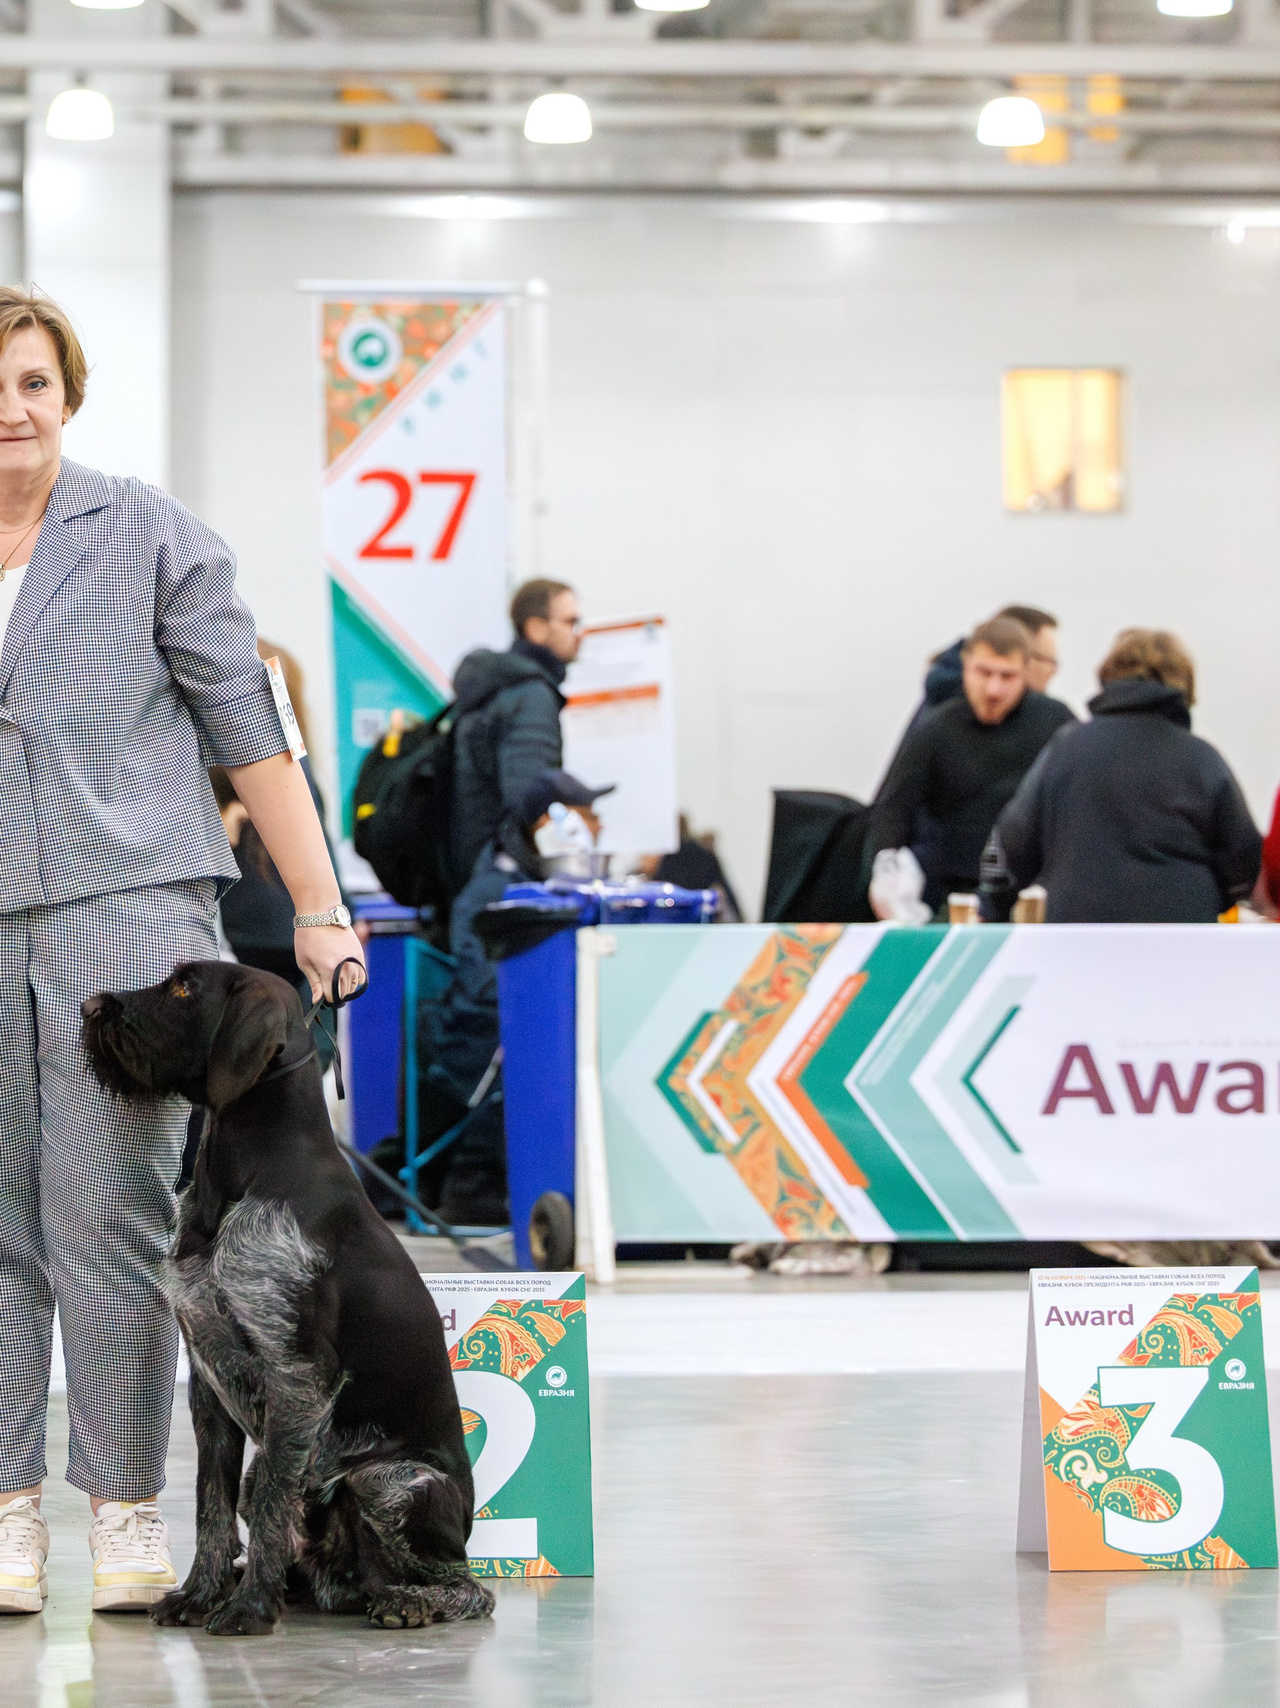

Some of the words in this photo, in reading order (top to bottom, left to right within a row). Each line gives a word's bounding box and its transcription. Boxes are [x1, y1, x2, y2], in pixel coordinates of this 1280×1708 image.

[358, 470, 477, 561] 27
[1041, 1043, 1280, 1116] Awa
[530, 1279, 551, 1287] ПОРОД
[1045, 1304, 1134, 1327] Award
[538, 1389, 575, 1397] ЕВРАЗИЯ
[1218, 1382, 1255, 1390] ЕВРАЗИЯ
[1097, 1366, 1225, 1555] 3
